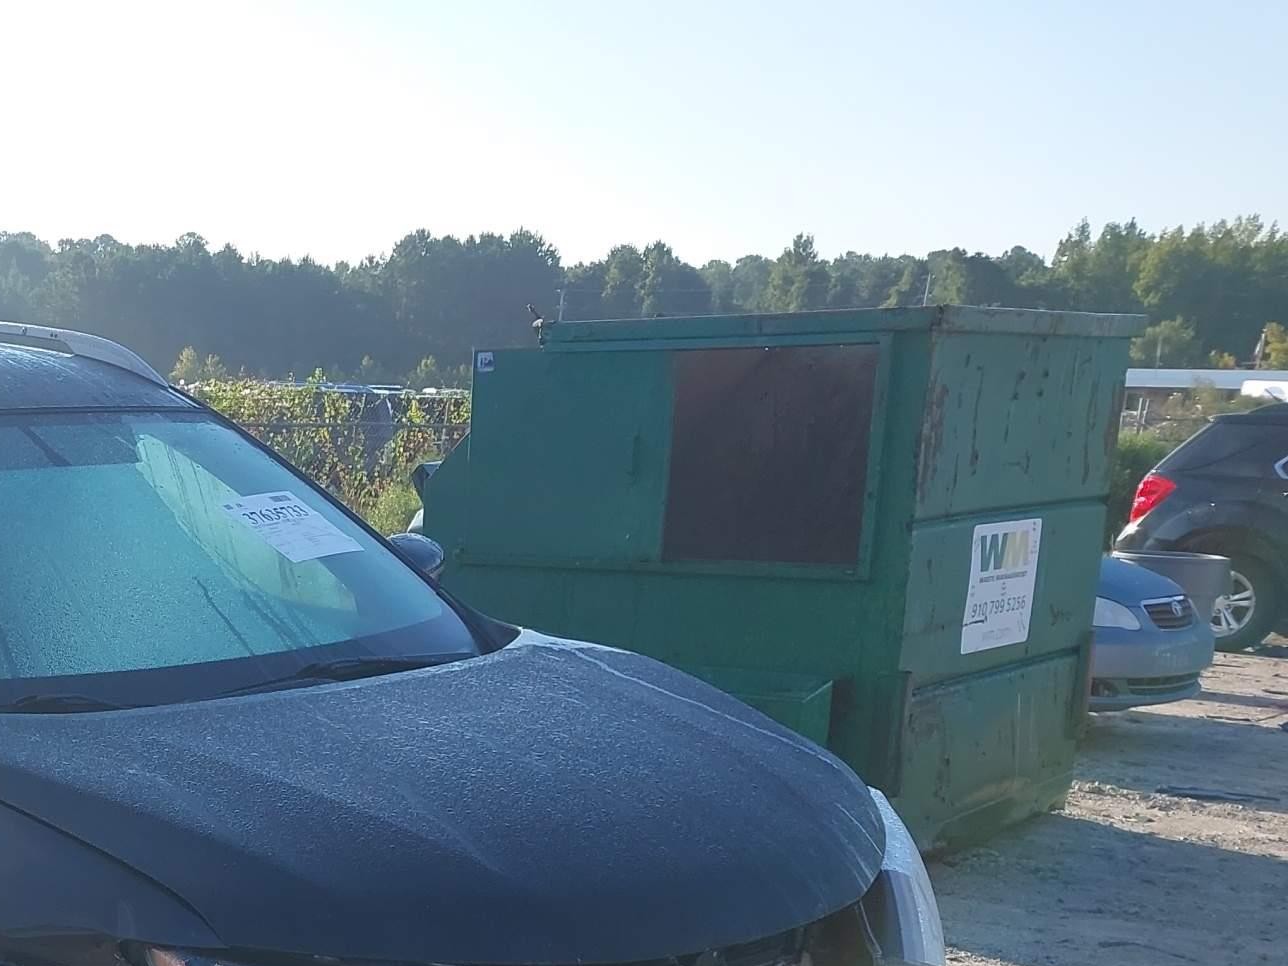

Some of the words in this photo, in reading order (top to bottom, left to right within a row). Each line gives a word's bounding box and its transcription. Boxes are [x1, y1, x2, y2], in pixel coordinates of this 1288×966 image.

[242, 504, 309, 525] 37635733
[980, 531, 1029, 572] WM
[971, 601, 988, 618] 910
[989, 598, 1005, 614] 799
[1006, 595, 1026, 612] 5256
